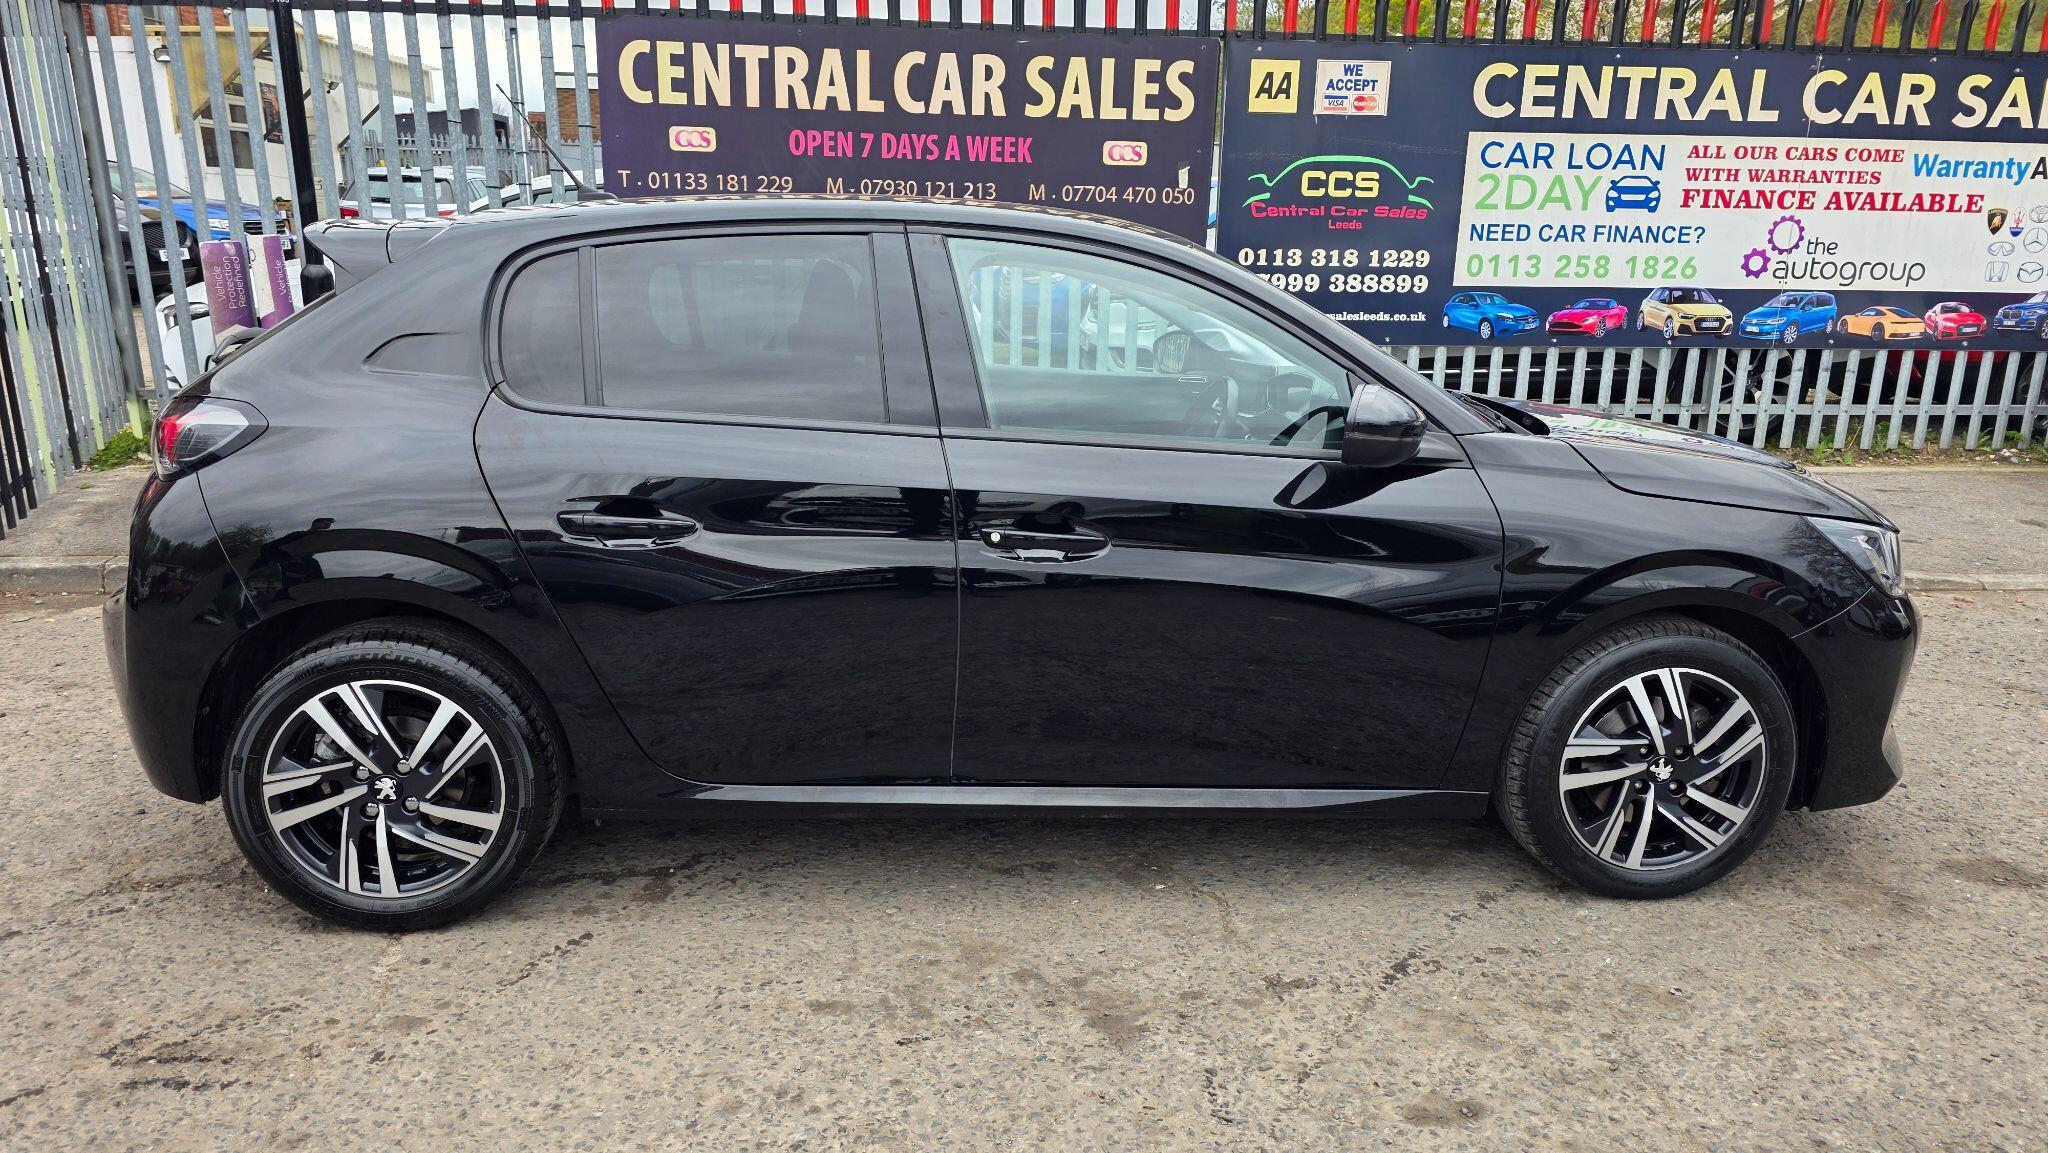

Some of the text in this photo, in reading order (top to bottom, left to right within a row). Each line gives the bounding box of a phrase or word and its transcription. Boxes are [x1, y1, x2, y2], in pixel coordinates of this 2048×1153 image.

[618, 39, 1195, 122] CENTRAL CAR SALES
[1343, 64, 1364, 76] WE
[1254, 71, 1293, 100] AA
[1326, 78, 1379, 92] ACCEPT
[1473, 62, 1780, 122] CENTRAL
[1803, 69, 1936, 126] CAR
[789, 129, 1033, 164] OPEN 7 DAYS A WEEK
[1480, 140, 1666, 171] CAR LOAN
[1686, 145, 1905, 163] ALL OUR CARS COME
[648, 172, 708, 191] 01133
[716, 174, 748, 192] 181
[756, 176, 793, 194] 229
[1301, 170, 1380, 198] CCS
[1685, 168, 1882, 185] WITH WARRANTIES
[860, 179, 918, 196] 07930
[925, 181, 955, 198] 121
[963, 182, 997, 200] 213
[1062, 185, 1118, 203] 07704
[1123, 186, 1156, 204] 470
[1162, 188, 1195, 205] 050
[1474, 173, 1604, 211] 2DAY
[1680, 189, 1985, 214] FINANCE AVAILABLE
[1250, 202, 1428, 220] Central Car Sales
[1328, 220, 1363, 230] Leeds
[1469, 224, 1706, 244] NEED CAR FINANCE?
[1238, 248, 1431, 268] 0113 318 1229
[1805, 236, 1839, 256] the
[275, 259, 287, 296] Vehicle
[1466, 254, 1698, 280] 0113 258 1826
[1772, 257, 1926, 287] autogroup
[212, 266, 226, 301] Vehicle
[223, 256, 238, 309] Protection
[230, 256, 247, 307] Redefined
[1328, 274, 1429, 294] 388899
